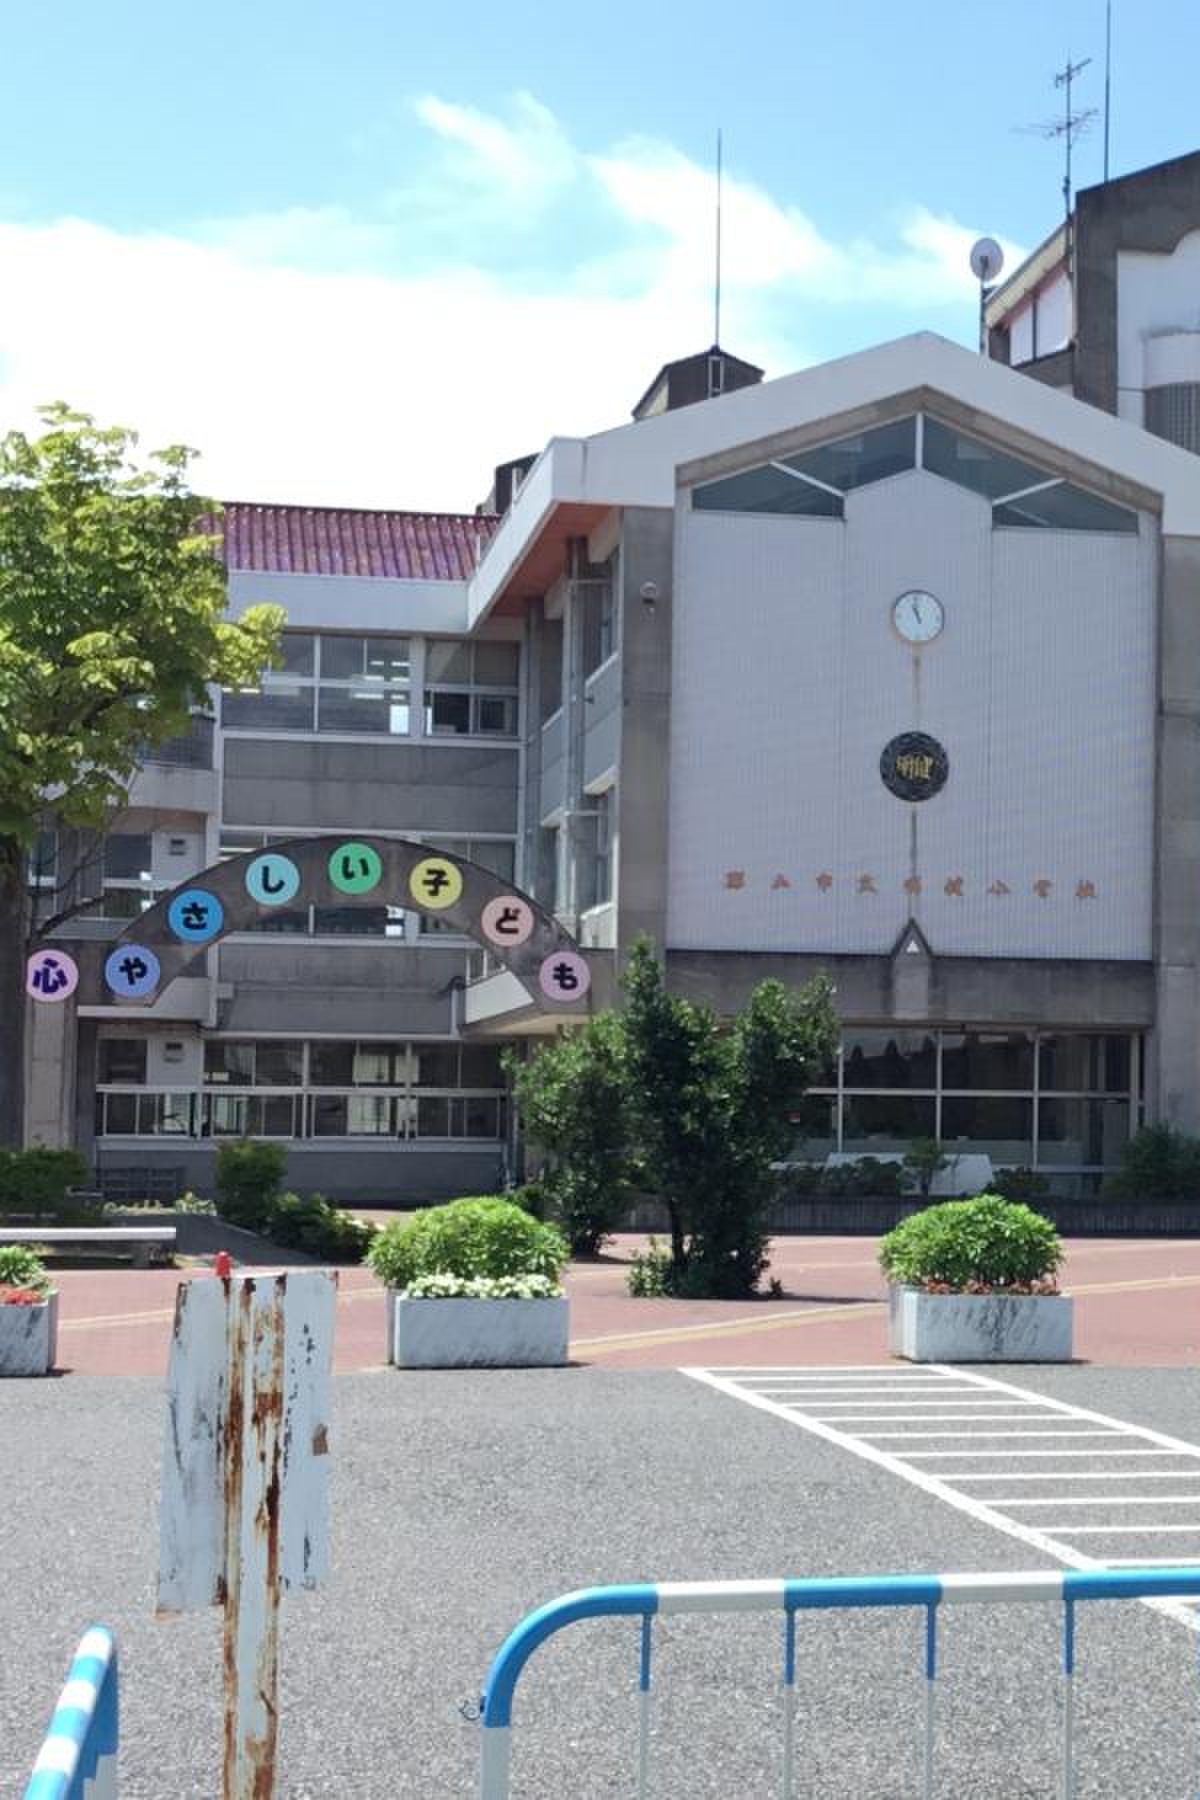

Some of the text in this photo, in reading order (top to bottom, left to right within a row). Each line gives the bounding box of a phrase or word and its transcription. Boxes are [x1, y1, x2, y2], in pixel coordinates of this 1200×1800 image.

[33, 856, 579, 993] 心やさしい子ども
